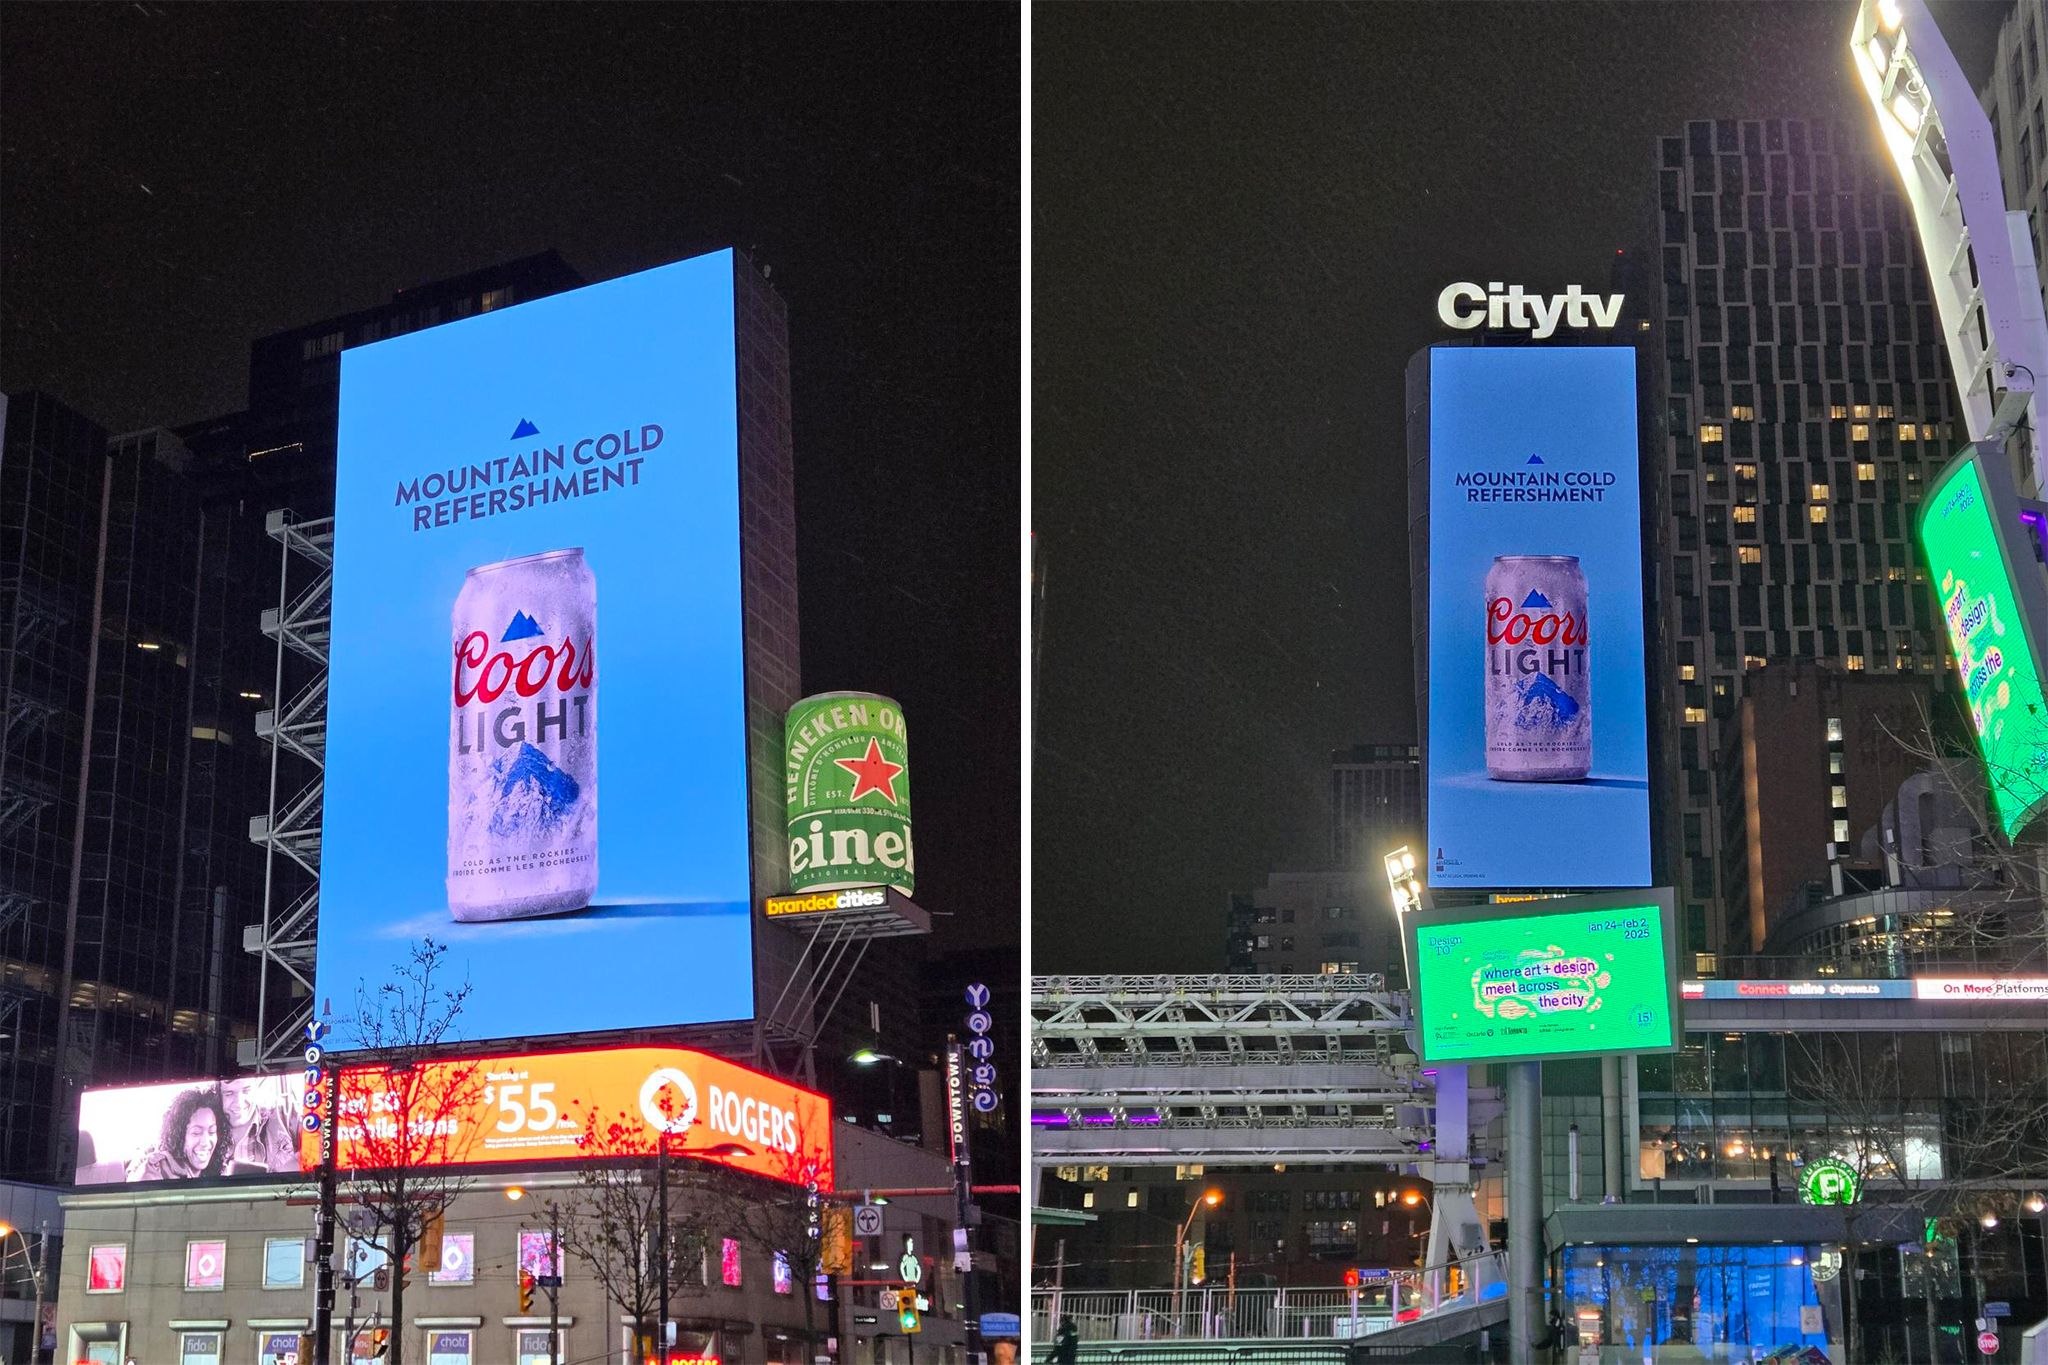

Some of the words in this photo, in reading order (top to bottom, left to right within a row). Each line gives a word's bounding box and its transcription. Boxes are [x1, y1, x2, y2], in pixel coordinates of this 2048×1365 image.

[1437, 281, 1625, 339] Citytv
[394, 445, 564, 507] MOUNTAIN
[573, 423, 664, 465] COLD
[1455, 471, 1560, 486] MOUNTAIN
[1564, 471, 1617, 486] COLD
[412, 457, 645, 532] REFERSHMENT
[1467, 487, 1606, 503] REFERSHMENT
[1486, 597, 1588, 646] Coors
[1960, 600, 1987, 638] design
[453, 630, 594, 708] Coors
[1490, 648, 1585, 675] LIGHT
[1984, 651, 2002, 675] the
[458, 695, 590, 756] LIGHT
[787, 704, 869, 805] HEINEKEN
[826, 790, 845, 799] EST.
[463, 859, 484, 867] COLD
[488, 857, 502, 865] AS
[506, 854, 526, 863] THE
[478, 865, 511, 875] COMME
[516, 863, 534, 871] LES
[1588, 921, 1603, 933] jan
[1624, 929, 1650, 940] 2025
[1429, 936, 1462, 947] Design
[1434, 946, 1451, 956] TO
[1484, 967, 1522, 979] where
[1524, 964, 1542, 977] art
[1553, 961, 1596, 975] design
[1485, 981, 1517, 995] meet
[1518, 981, 1560, 992] across
[1738, 983, 1787, 995] Connect
[1788, 983, 1826, 995] online
[1943, 983, 1961, 993] On
[1963, 984, 1993, 993] More
[1538, 995, 1559, 1008] the
[1561, 994, 1584, 1008] city
[966, 983, 995, 1113] Yonge
[303, 1020, 322, 1132] Yonge
[485, 1071, 519, 1082] Starting
[519, 1070, 528, 1080] at
[949, 1052, 964, 1144] DOWNTOWN
[323, 1077, 334, 1160] DOWNTOWN
[708, 1084, 796, 1155] ROGERS
[407, 1115, 458, 1141] plans
[186, 1338, 207, 1352] fido
[1980, 1339, 1998, 1349] STOP
